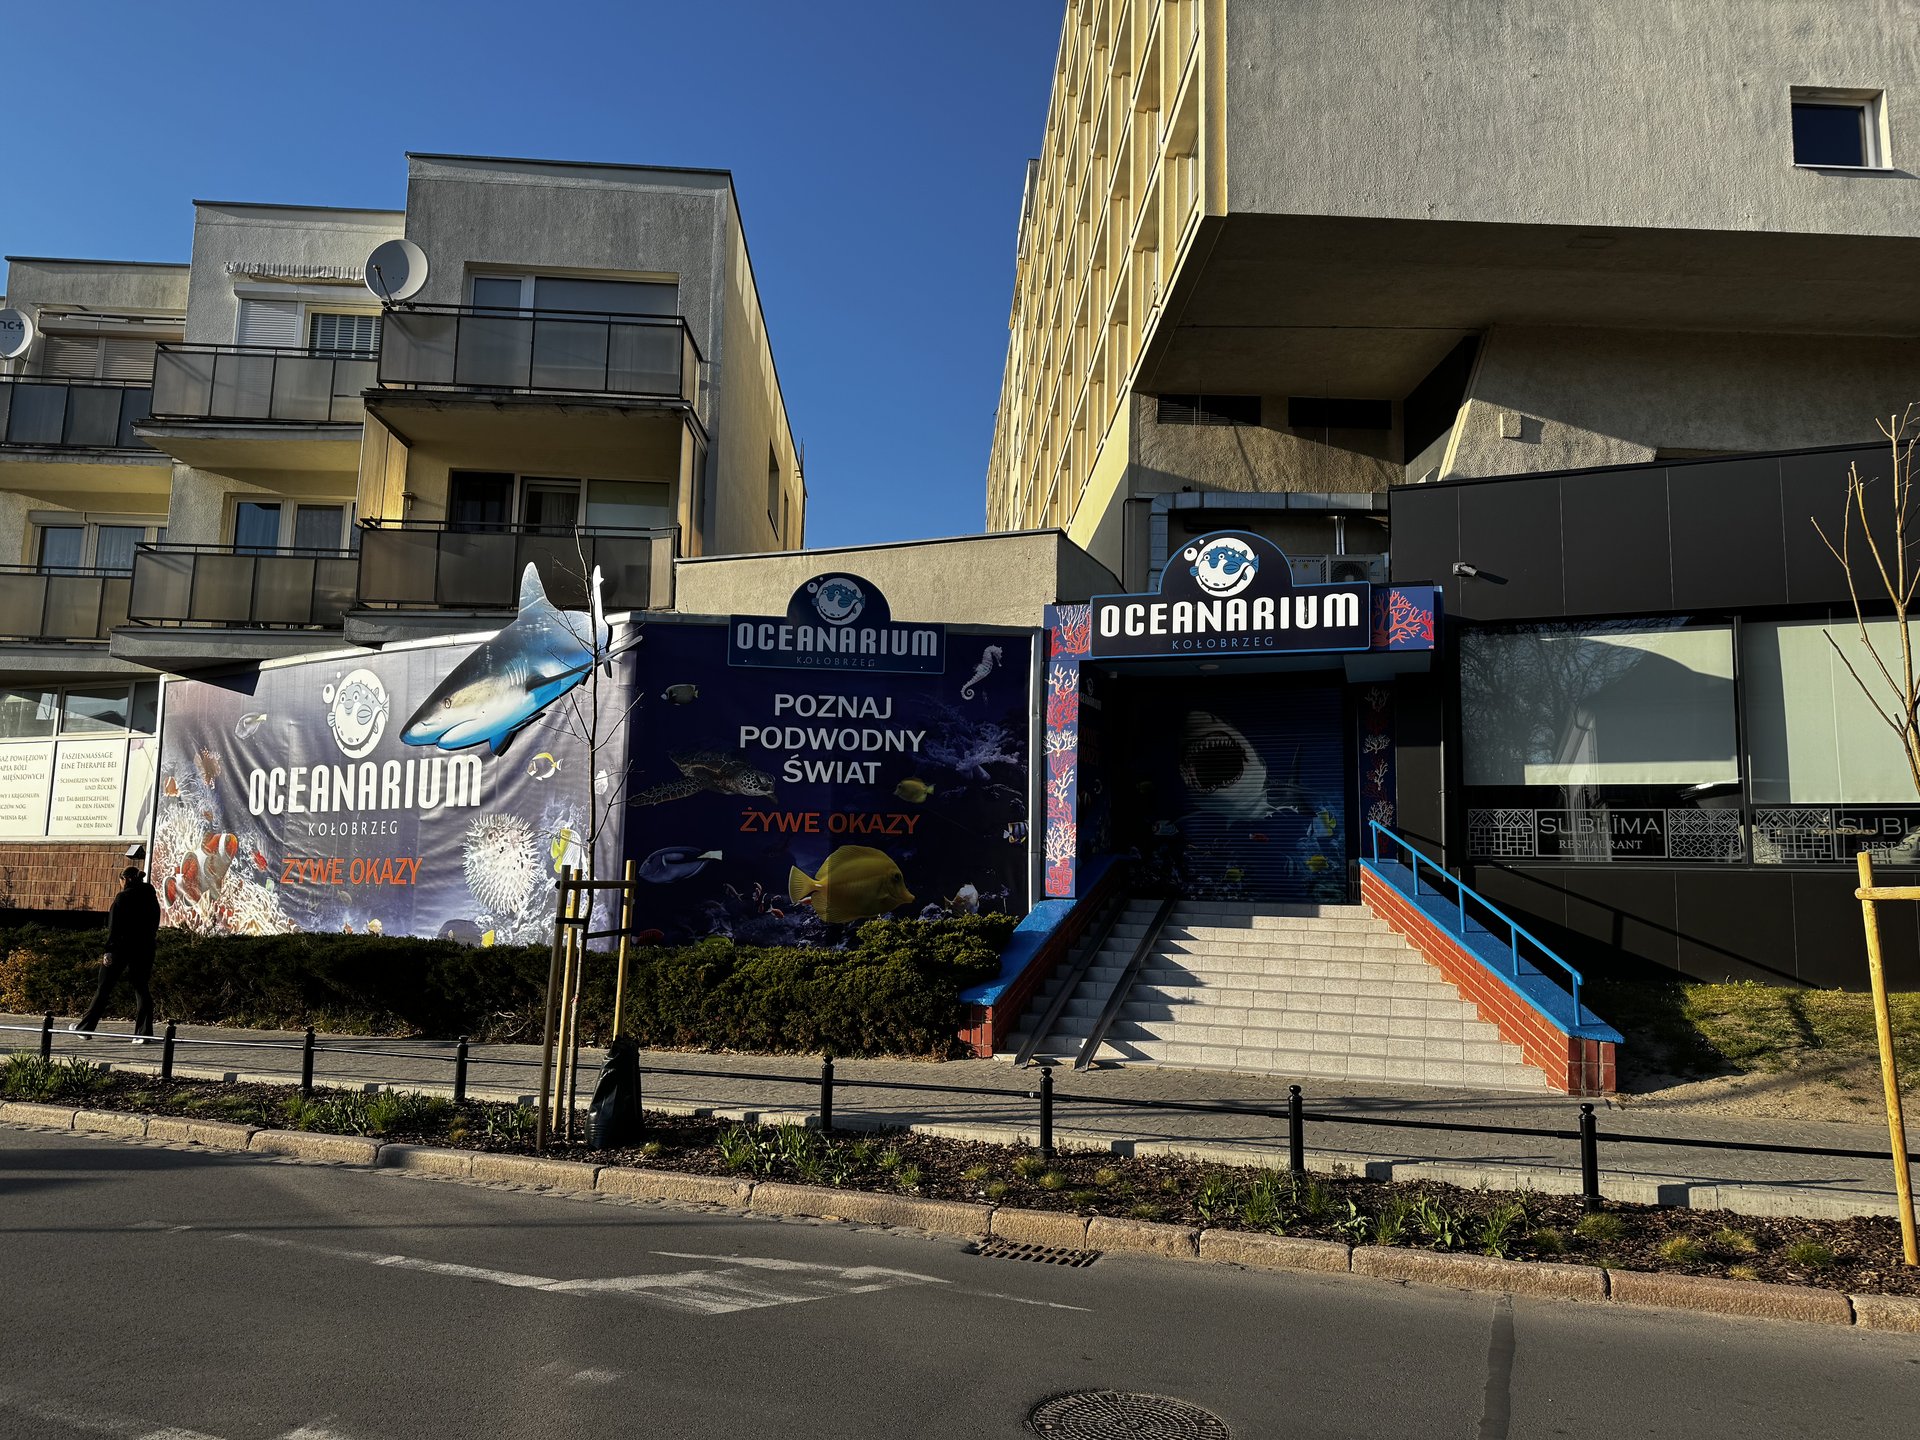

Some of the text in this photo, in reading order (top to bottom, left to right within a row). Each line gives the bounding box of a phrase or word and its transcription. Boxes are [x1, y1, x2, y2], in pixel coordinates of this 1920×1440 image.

[1100, 592, 1359, 638] OCEANARIUM
[737, 622, 938, 657] OCEANARIUM
[1172, 636, 1275, 650] KOŁOBRZEG
[796, 656, 876, 668] KOŁOBRZEG
[774, 693, 892, 719] POZNAJ
[740, 725, 926, 752] PODWODNY
[61, 751, 113, 760] FASZIENMASSAGE
[77, 761, 106, 769] THERAPIE
[782, 754, 881, 785] ŚWIAT
[249, 754, 482, 816] OCEANARIUM
[308, 820, 398, 837] KOŁOBRZEG
[740, 806, 920, 835] ŻYWE OKAZY
[1558, 839, 1643, 850] RESTAURANT
[280, 853, 423, 885] ŻYWE OKAZY
